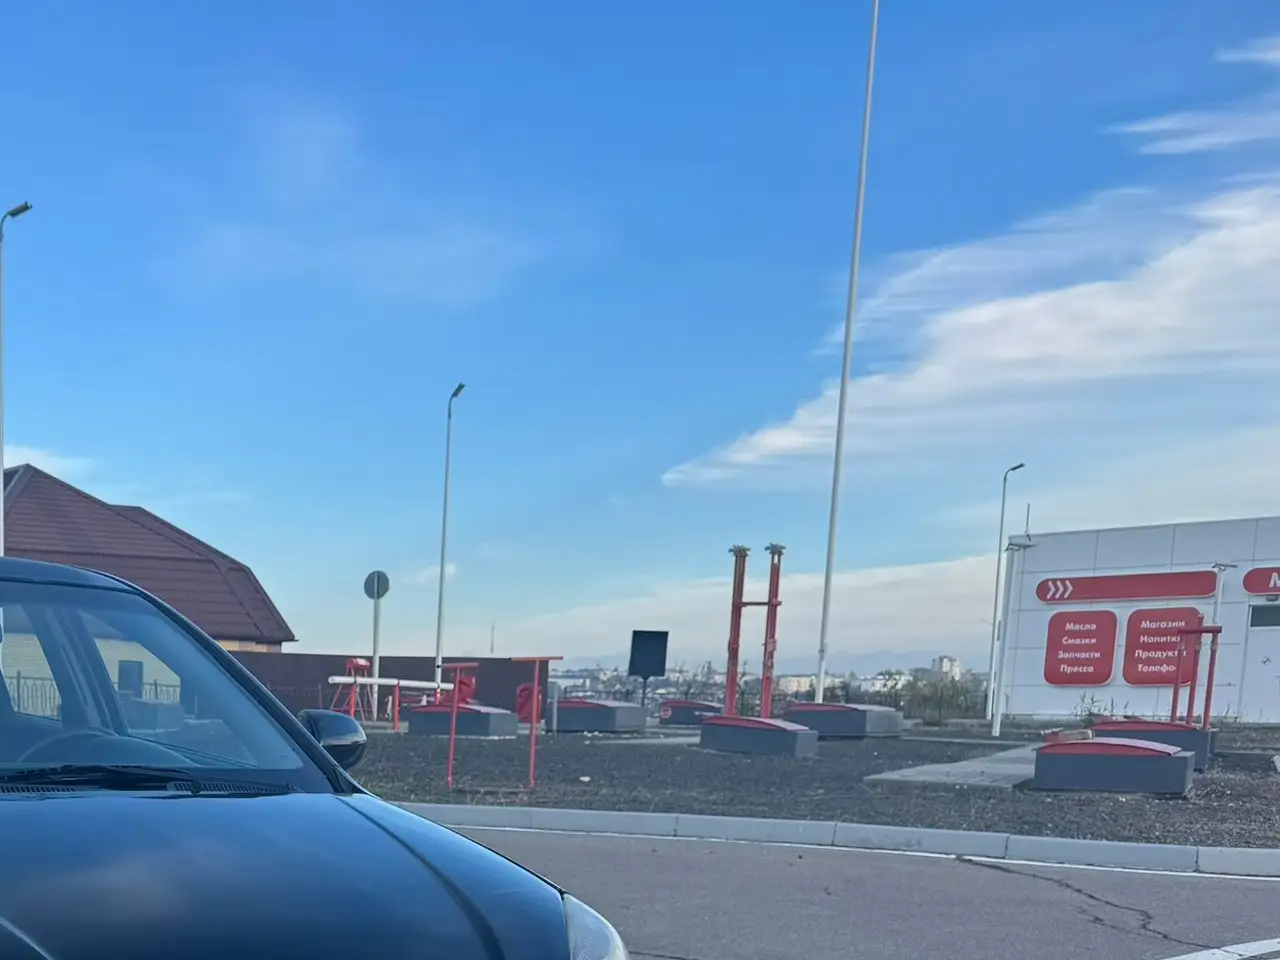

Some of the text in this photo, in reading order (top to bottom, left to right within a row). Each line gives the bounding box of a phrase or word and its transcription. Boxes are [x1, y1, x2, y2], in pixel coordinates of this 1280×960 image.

[1140, 620, 1186, 629] Магазин
[1062, 636, 1097, 645] Смазки
[1057, 650, 1101, 659] Запчасти
[1060, 664, 1095, 674] Пресса
[1137, 663, 1177, 673] Телефо
